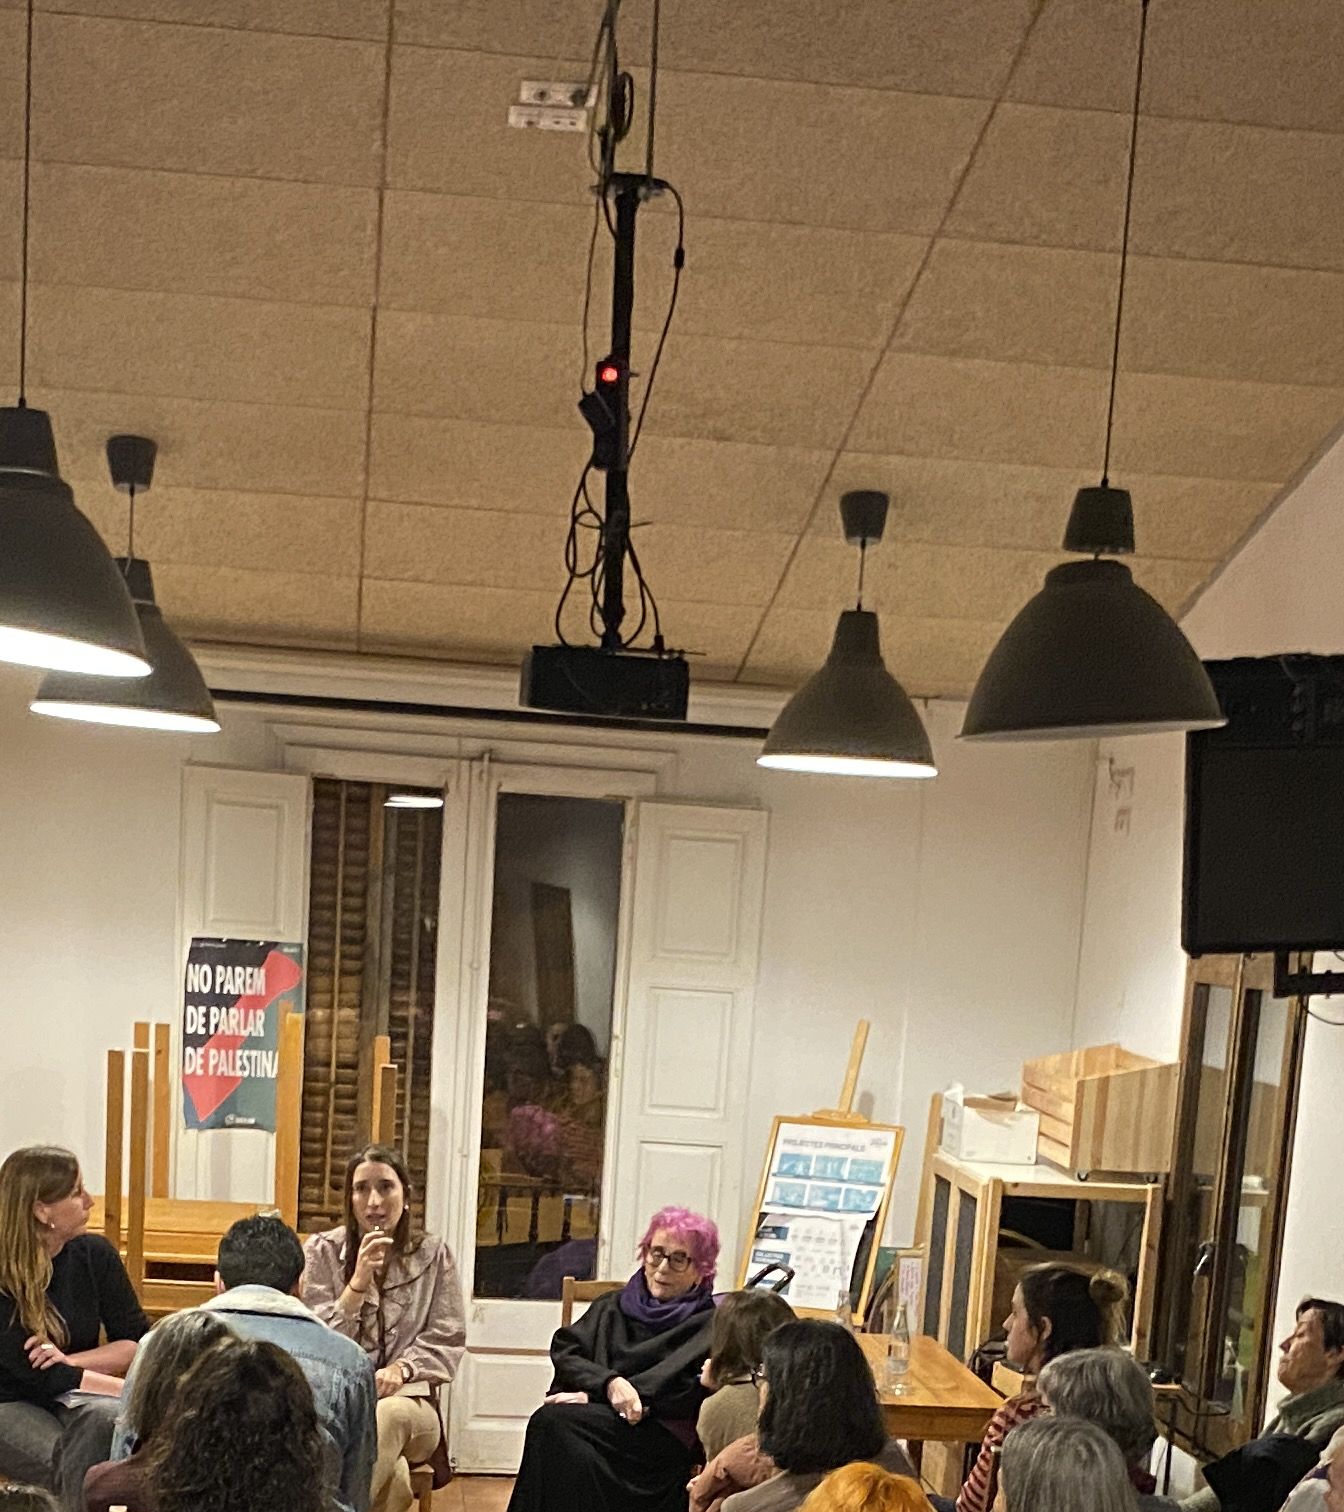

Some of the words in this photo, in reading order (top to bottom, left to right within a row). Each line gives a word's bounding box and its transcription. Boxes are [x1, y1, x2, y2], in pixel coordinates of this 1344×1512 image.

[187, 964, 213, 993] NO
[215, 966, 265, 995] PAREM
[186, 1005, 207, 1036] DE
[209, 1007, 265, 1037] PARLAR
[184, 1047, 205, 1076] DE
